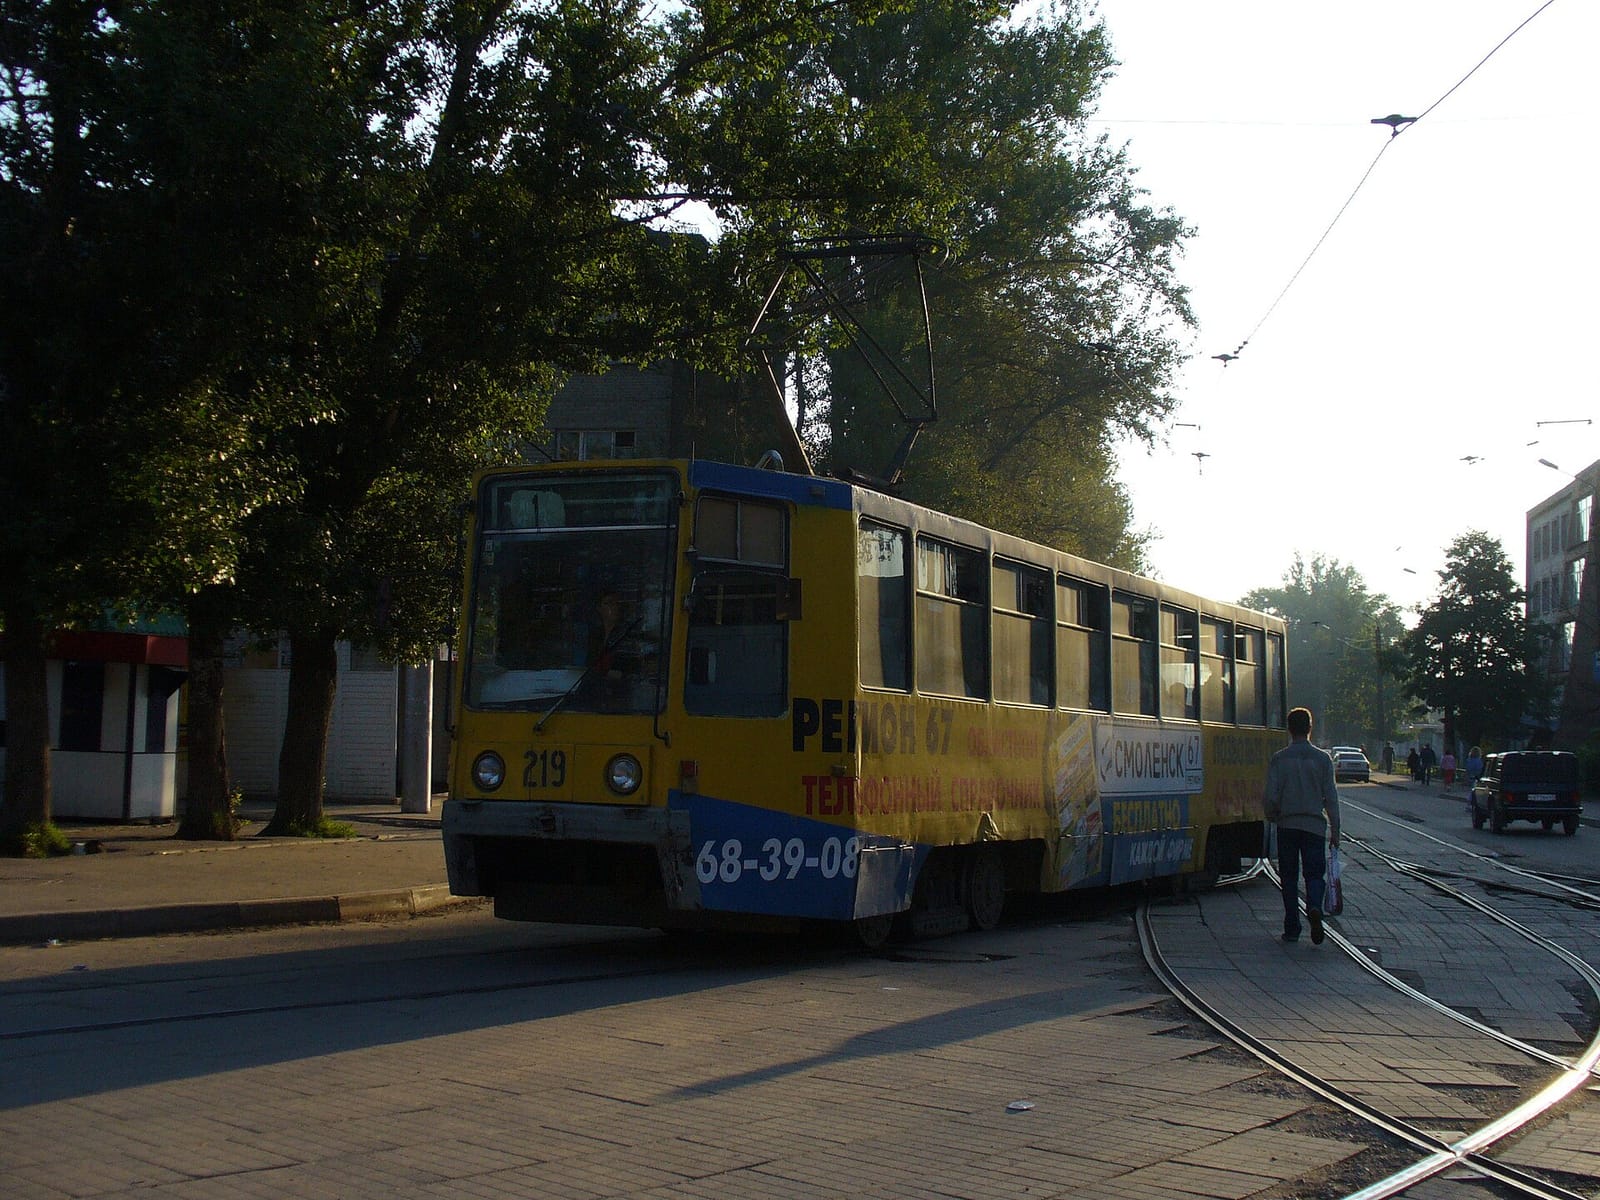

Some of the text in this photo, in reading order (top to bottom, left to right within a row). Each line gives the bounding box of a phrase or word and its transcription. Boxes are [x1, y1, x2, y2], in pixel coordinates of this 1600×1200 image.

[926, 707, 954, 755] 67
[523, 750, 566, 788] 219
[1113, 738, 1185, 779] СМОЛЕНСК
[1187, 735, 1200, 765] 67
[1112, 798, 1181, 834] БЕСПЛАТНО
[695, 837, 861, 883] 68-39-08
